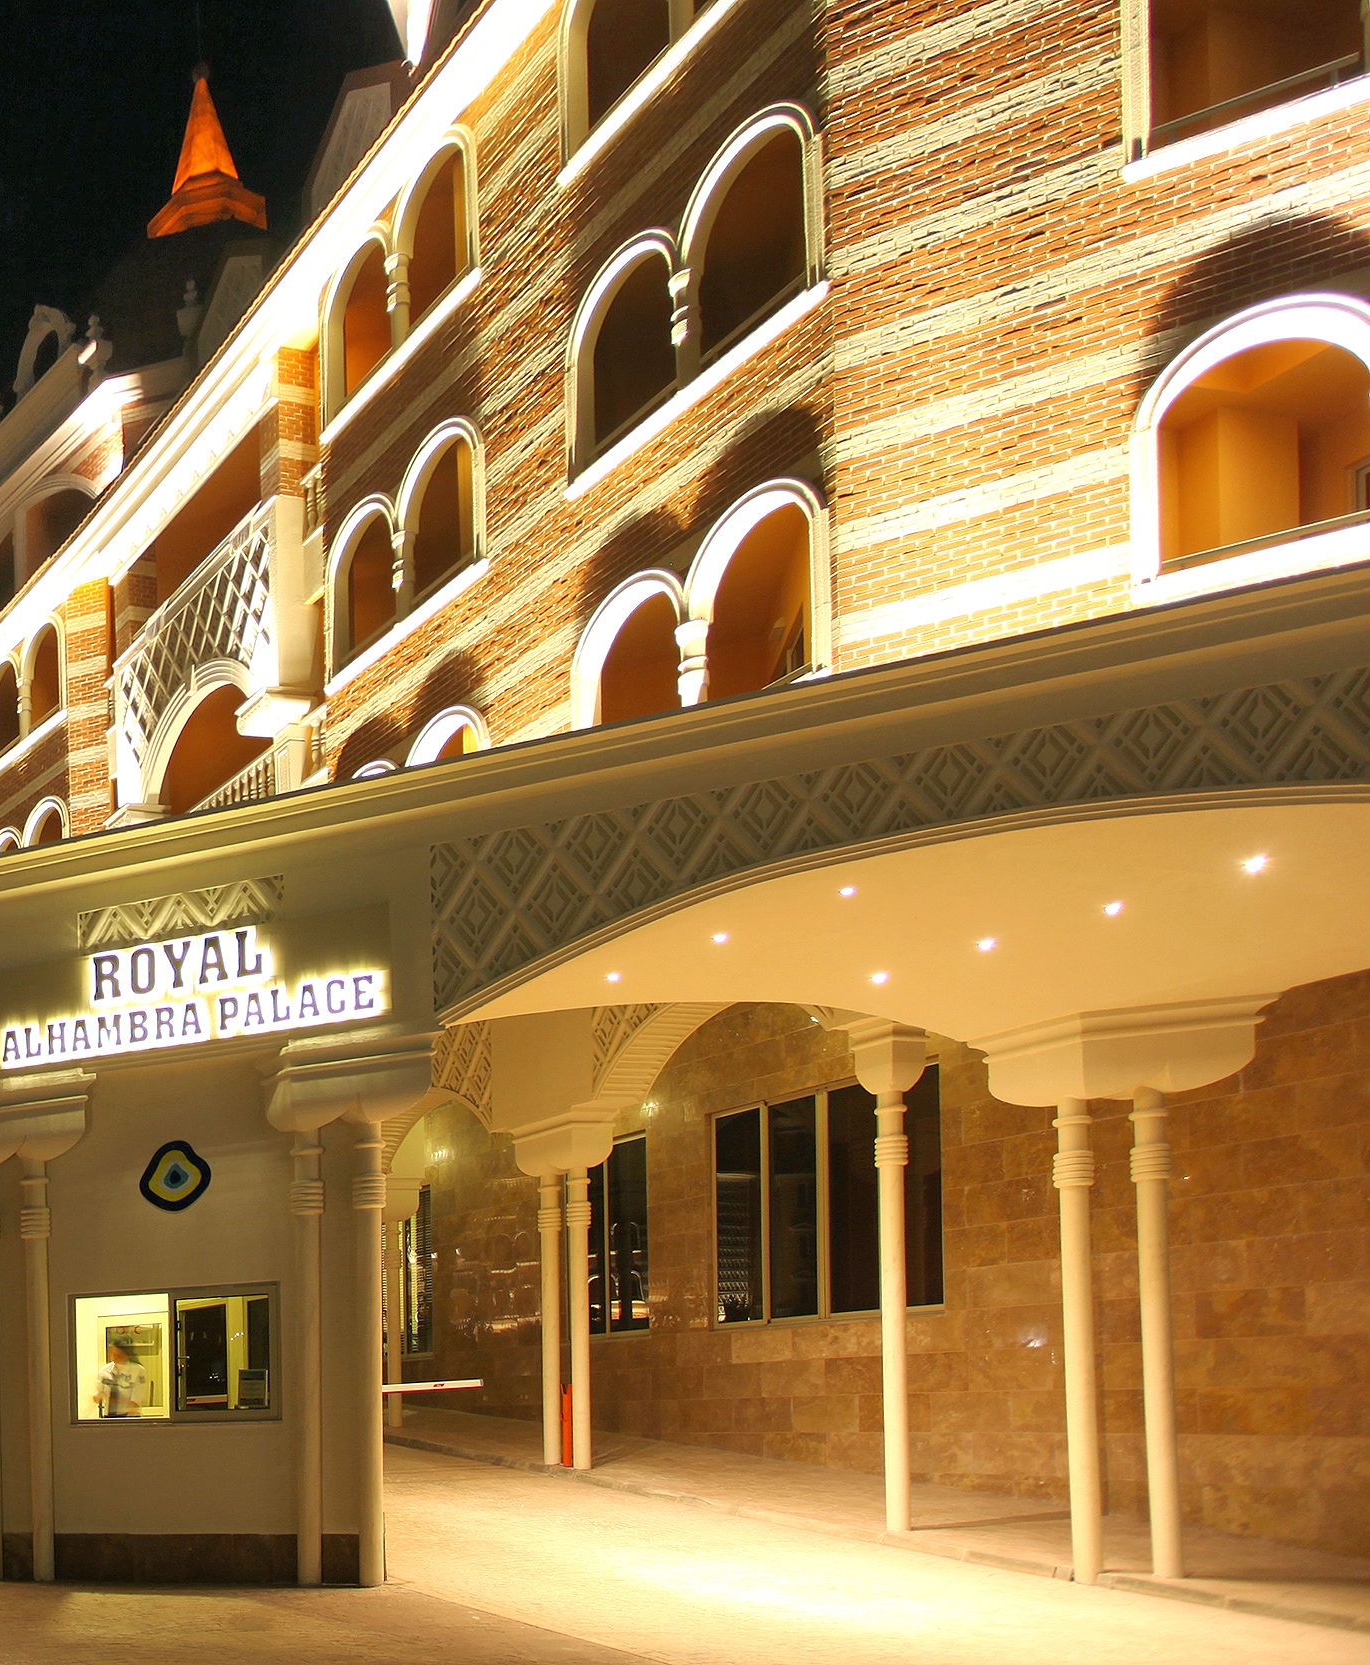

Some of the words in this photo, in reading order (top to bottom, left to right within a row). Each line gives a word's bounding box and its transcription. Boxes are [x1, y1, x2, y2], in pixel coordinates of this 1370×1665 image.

[93, 931, 263, 1001] ROYAL
[2, 1003, 202, 1062] ALHAMBRA
[218, 975, 375, 1031] PALACE
